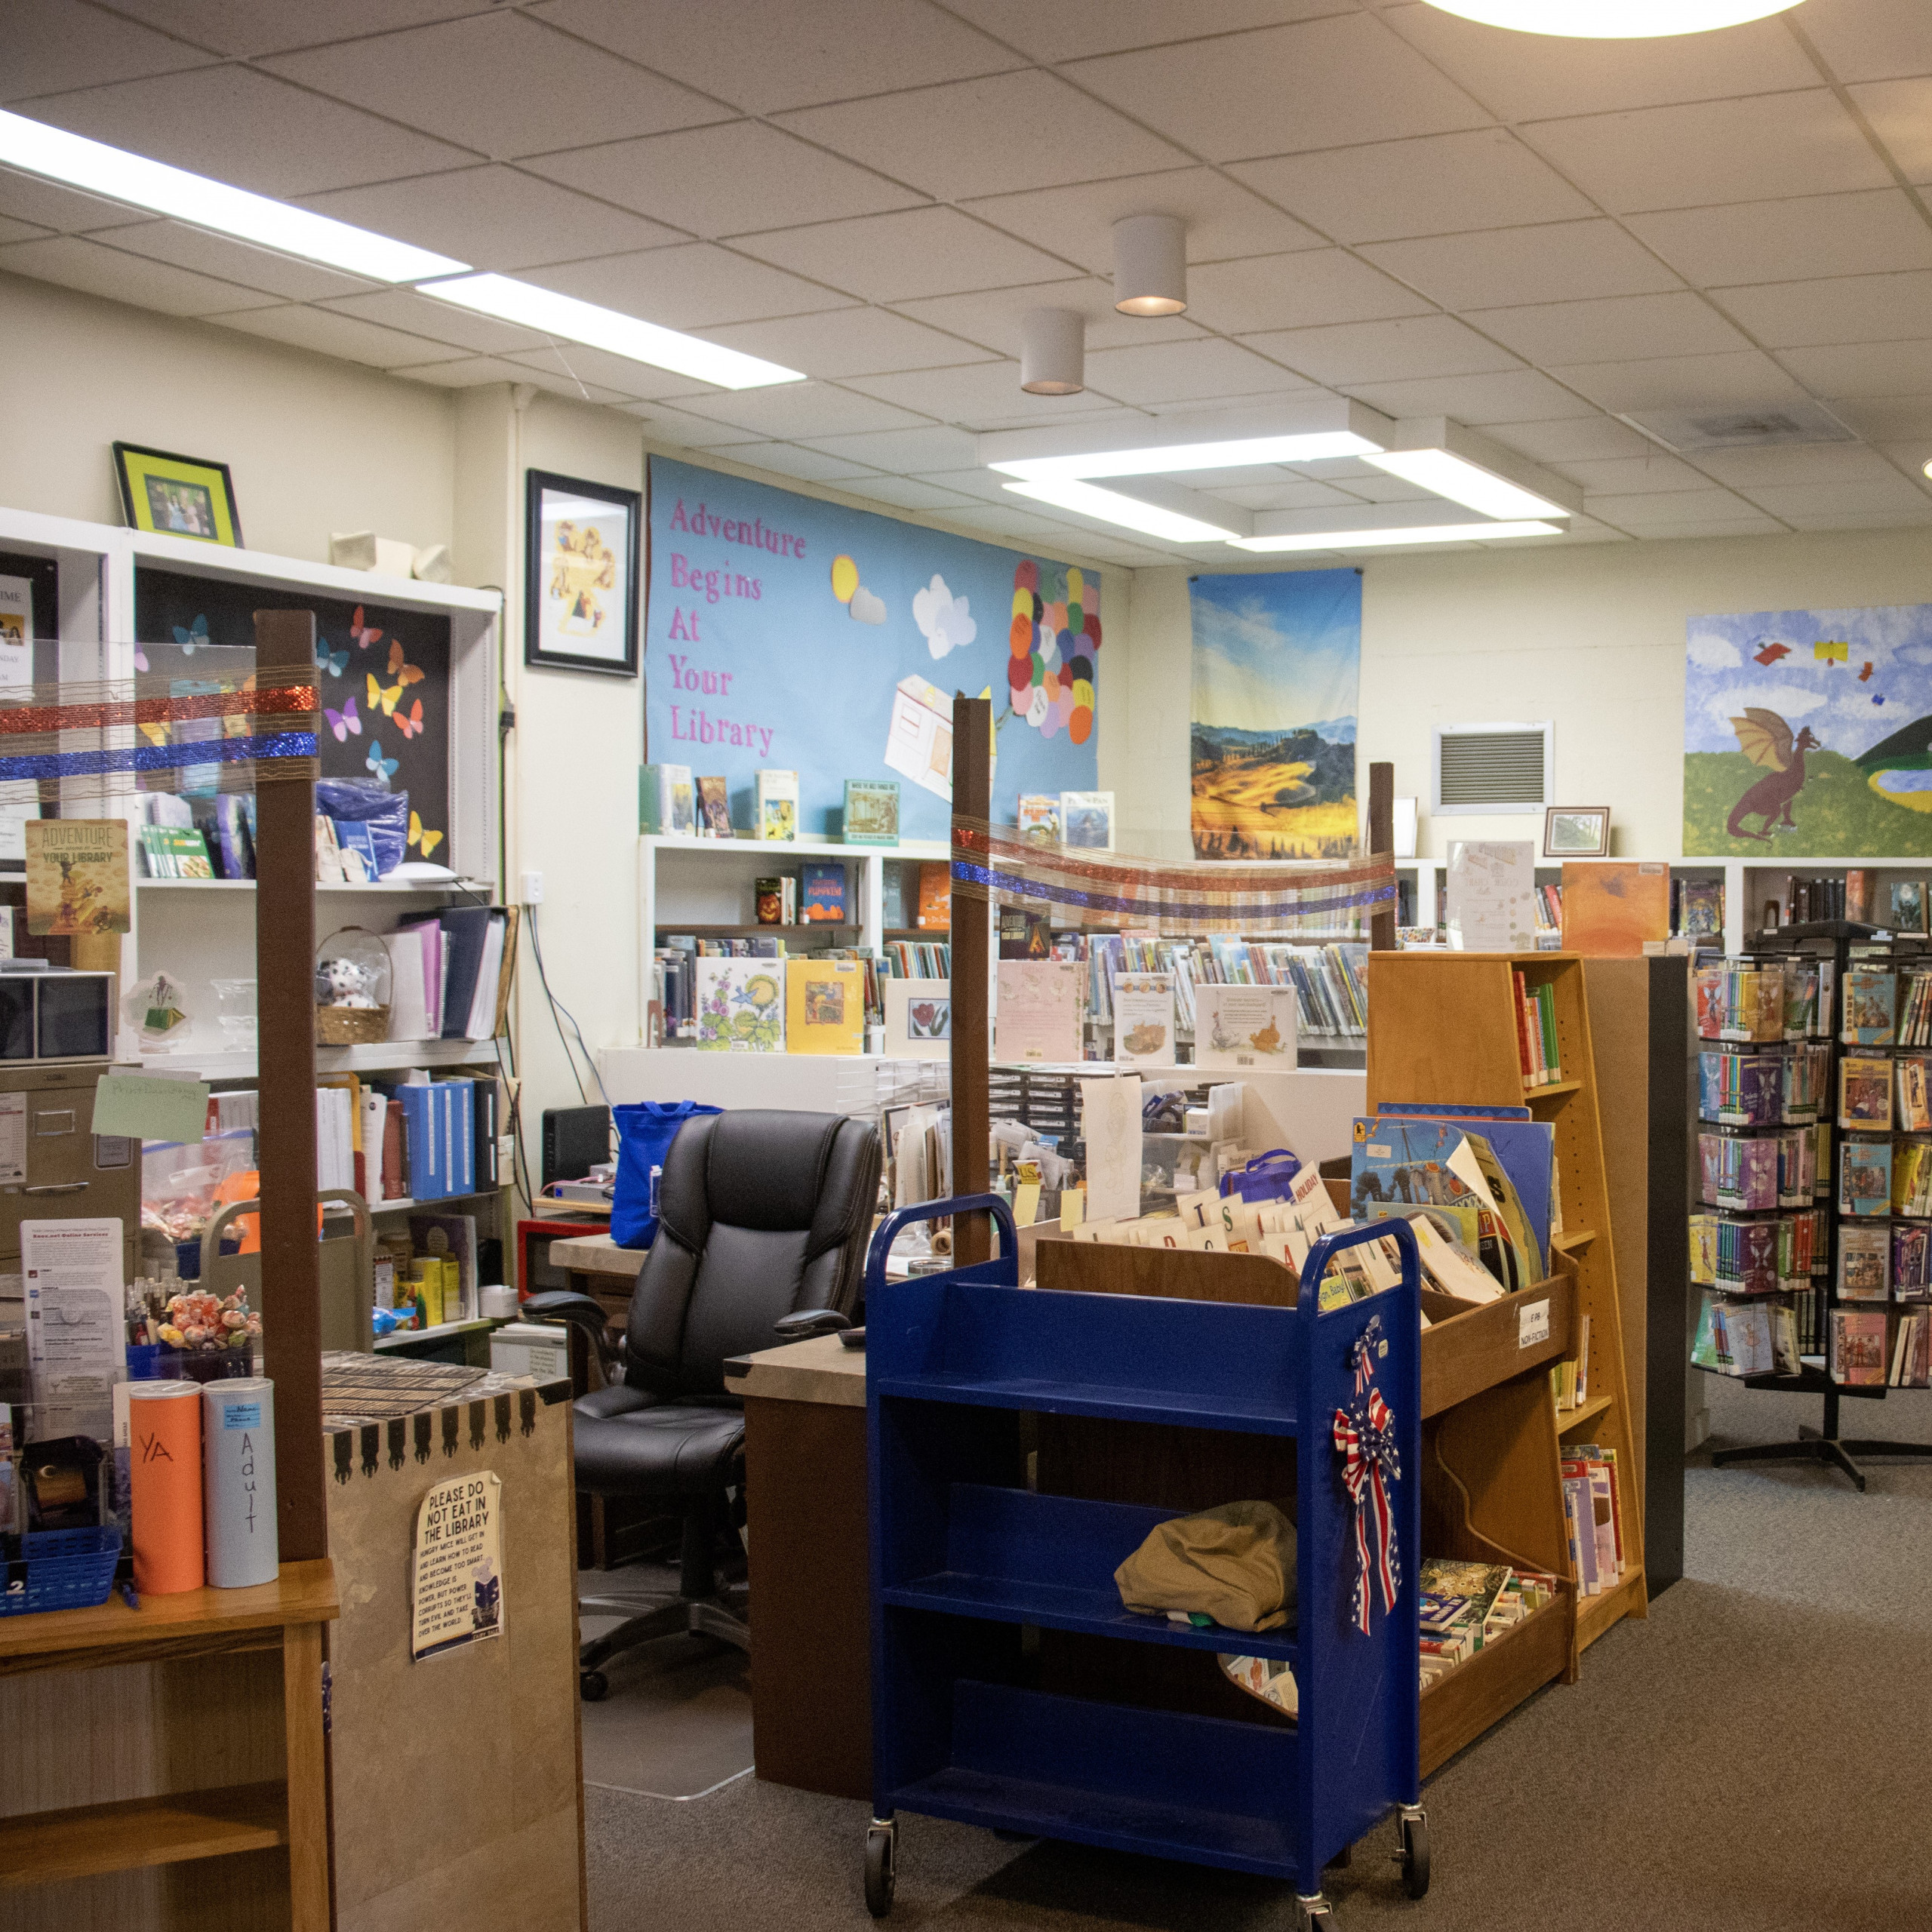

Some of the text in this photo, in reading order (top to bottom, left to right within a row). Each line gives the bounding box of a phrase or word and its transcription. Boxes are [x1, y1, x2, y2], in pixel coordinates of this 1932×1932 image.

[669, 498, 806, 559] Adventure
[670, 552, 762, 604] Begins
[669, 606, 701, 642] At
[668, 654, 733, 696] Your
[670, 704, 774, 758] Library
[42, 827, 114, 848] ADVENTURE
[43, 852, 112, 863] YOUR LIBRARY
[1295, 1173, 1319, 1203] HOLIDAY
[1193, 1203, 1206, 1227] T
[1222, 1206, 1233, 1232] S
[1521, 1328, 1548, 1345] NON-FICTION
[139, 1432, 174, 1463] YA
[242, 1432, 257, 1533] Adult
[429, 1481, 484, 1510] PLEASE DO
[427, 1496, 486, 1527] NOT EAT IN
[425, 1510, 489, 1545] THE LIBRARY
[420, 1545, 438, 1558] HUNGRY
[440, 1540, 454, 1551] MICE
[455, 1536, 467, 1546] WILL
[468, 1532, 478, 1541] GET
[420, 1543, 483, 1571] AND LEARN HOW TO READ
[419, 1575, 457, 1595] KNOWLEDGE IS
[420, 1573, 429, 1583] AND
[429, 1564, 453, 1579] BECOME
[454, 1561, 466, 1570] TOO
[6, 1580, 26, 1595] 2
[437, 1589, 448, 1600] BUT
[449, 1583, 467, 1595] POWER
[418, 1592, 472, 1617] CORRUPTS SO THEY'LL
[418, 1604, 469, 1627] TURN EVIL AND TAKE
[418, 1627, 430, 1638] OVER
[432, 1623, 441, 1633] THE
